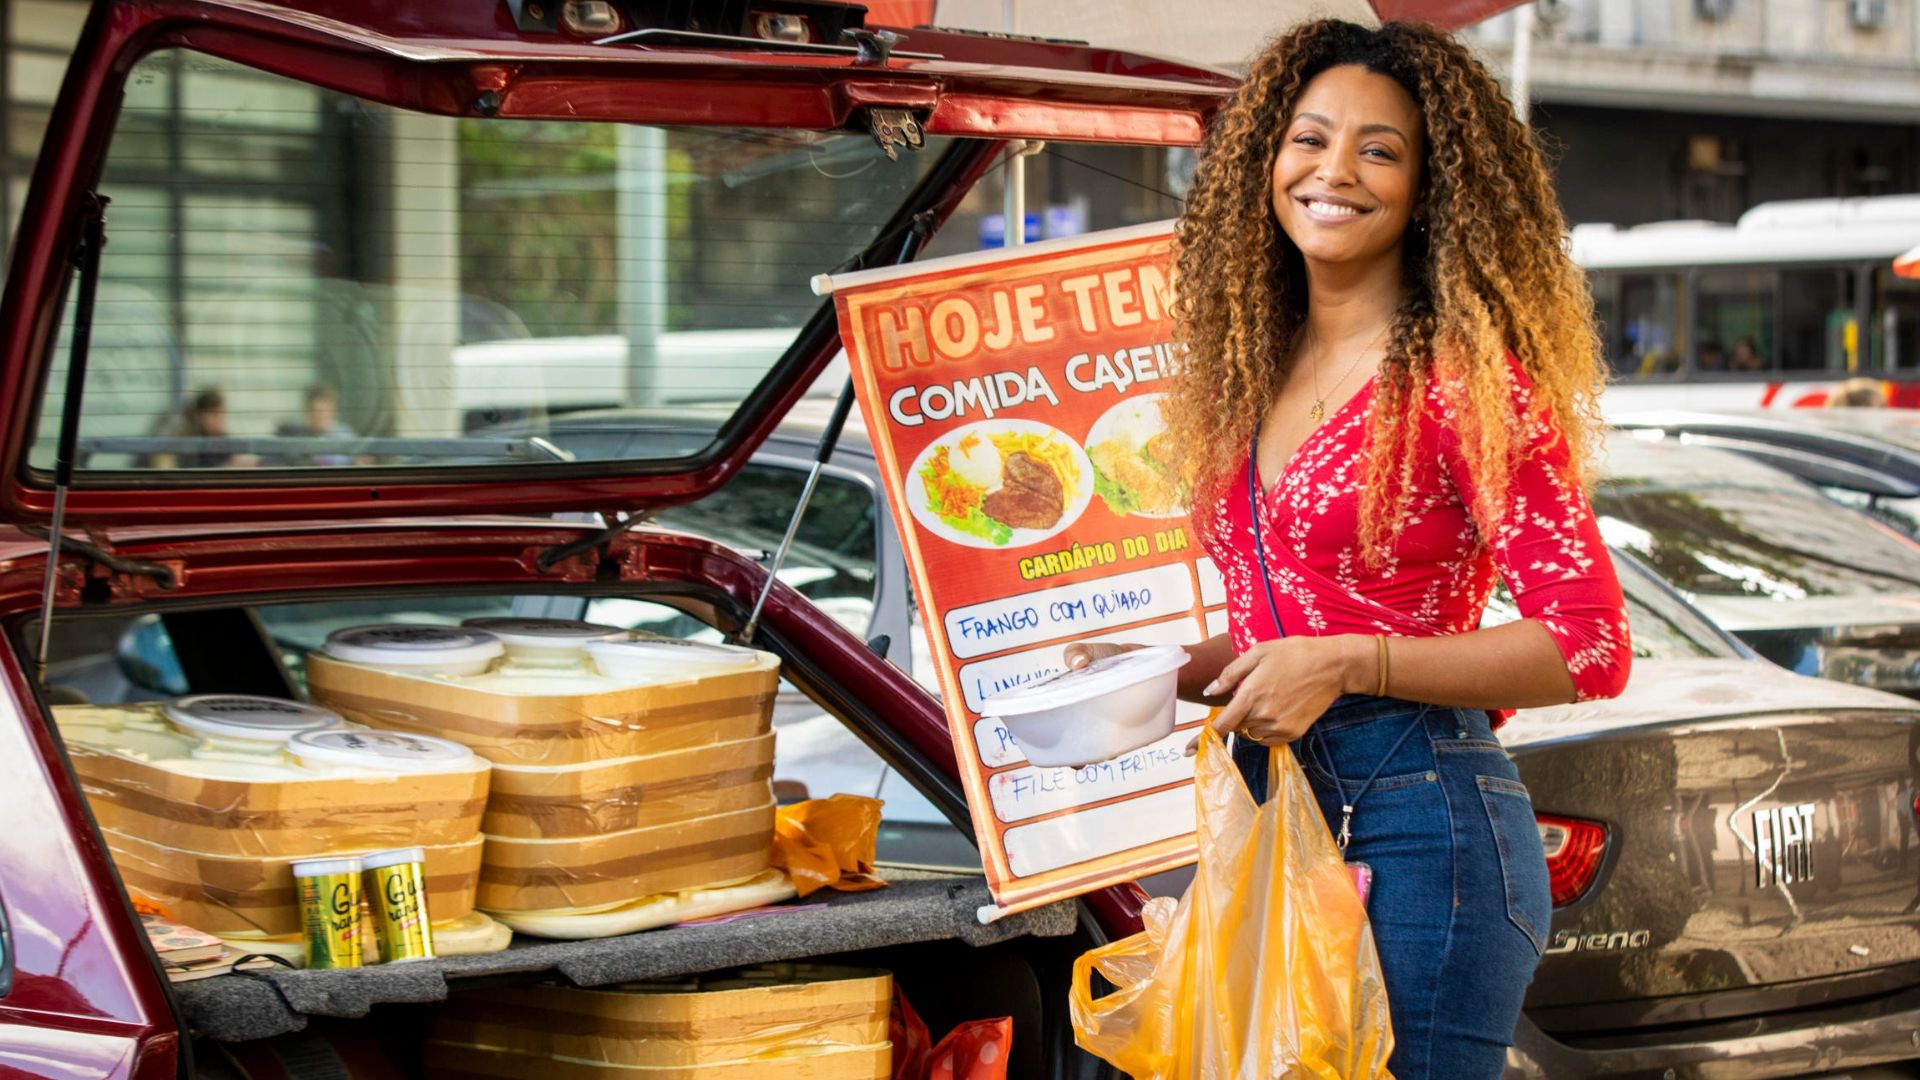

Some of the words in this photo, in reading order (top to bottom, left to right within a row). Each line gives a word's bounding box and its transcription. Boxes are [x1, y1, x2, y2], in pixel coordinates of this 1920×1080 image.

[878, 283, 1054, 370] HOJE
[889, 366, 1060, 427] COMIDA
[1018, 541, 1117, 581] CARDÁPIO
[1121, 535, 1150, 561] DO
[1155, 527, 1188, 554] DIA
[956, 607, 1039, 640] FRANGO
[1050, 599, 1087, 622] COM
[1092, 588, 1151, 619] QUIABO
[1075, 763, 1114, 785] COM
[1119, 747, 1181, 782] FRITAS
[1753, 802, 1816, 889] FIAT
[1544, 929, 1650, 955] Siena
